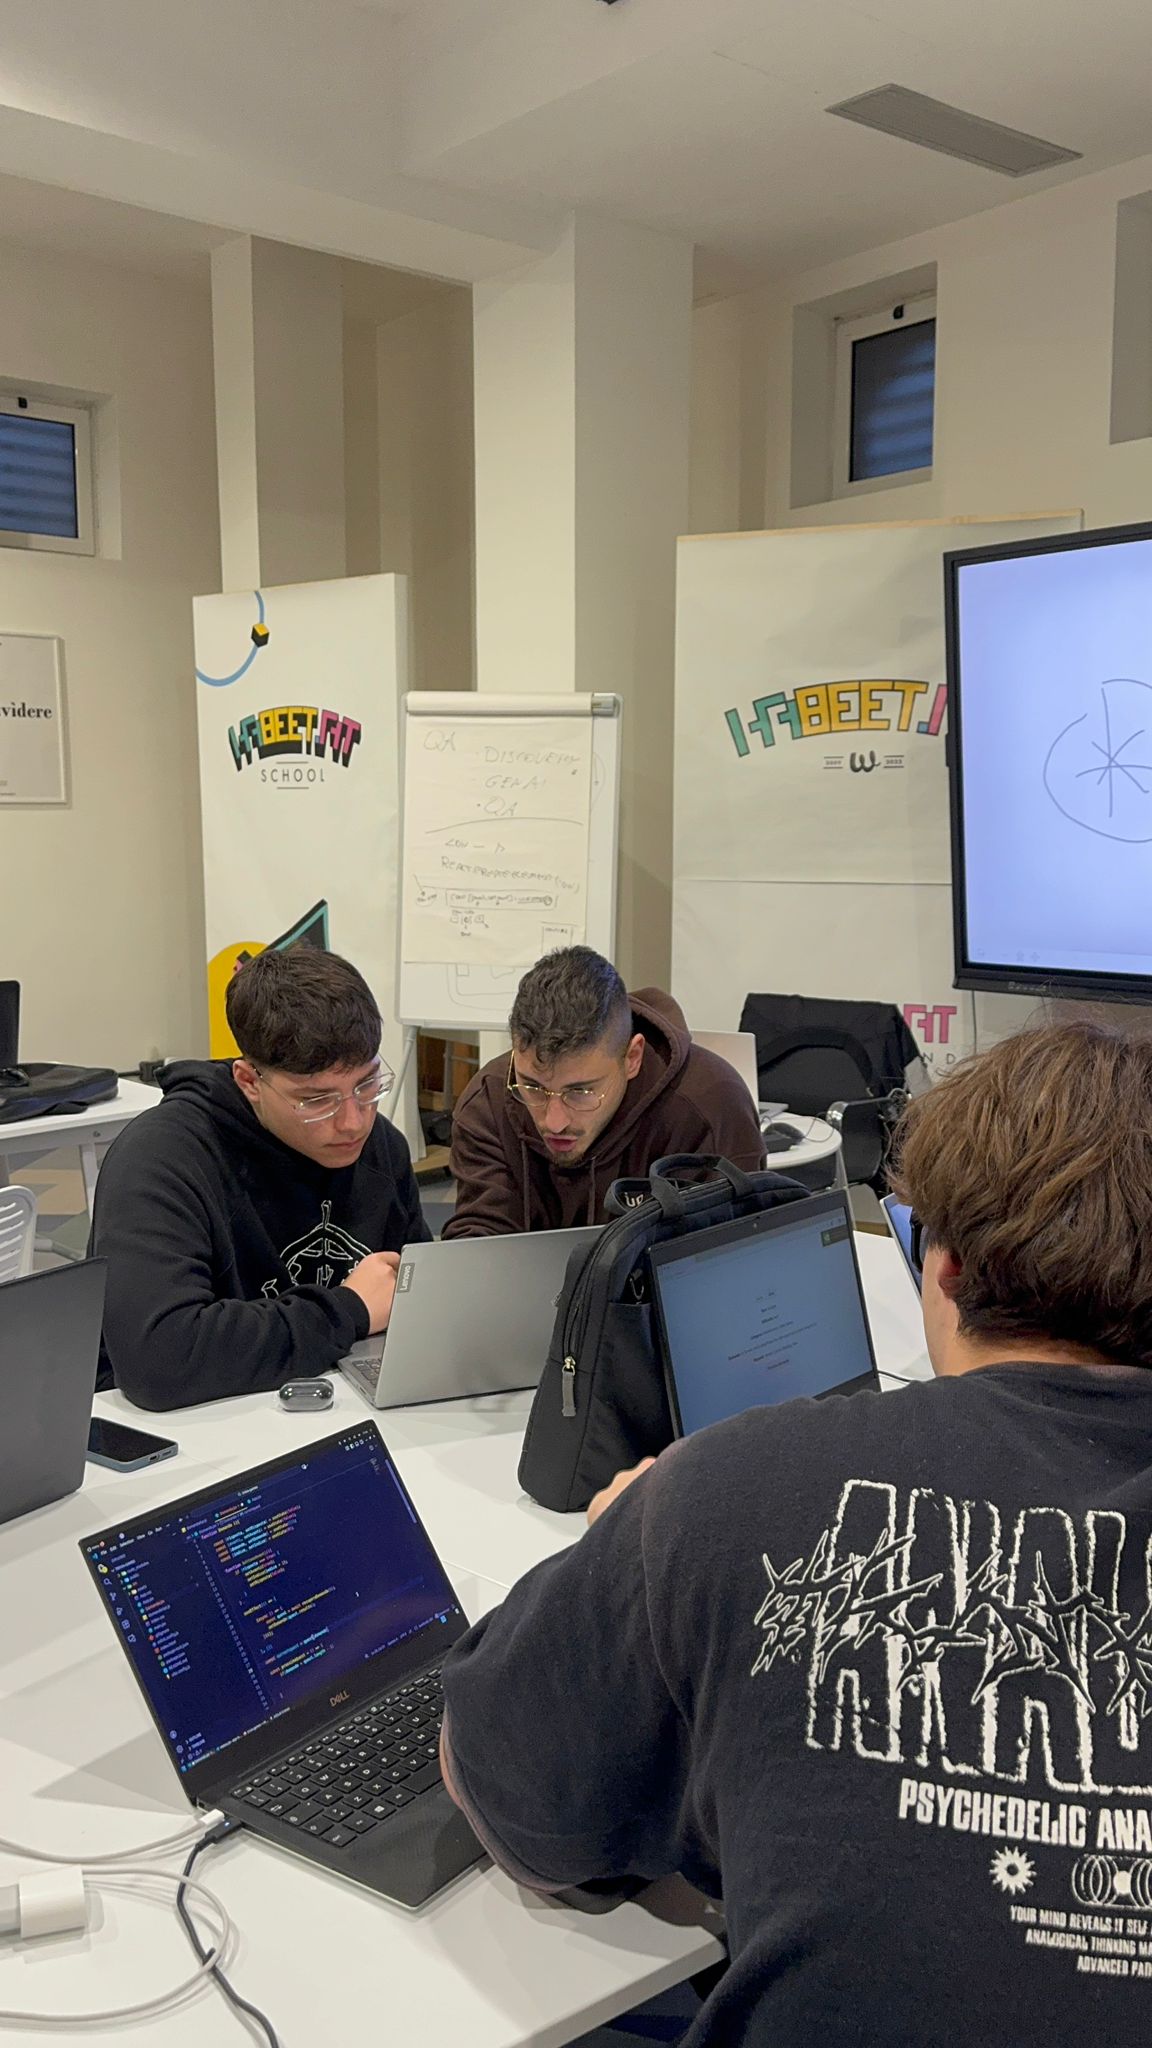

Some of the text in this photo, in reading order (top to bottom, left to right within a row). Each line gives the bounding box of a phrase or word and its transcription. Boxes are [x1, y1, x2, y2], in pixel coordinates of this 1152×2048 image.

[0, 702, 52, 719] vìdere
[261, 768, 326, 783] SCHOOL
[400, 1265, 411, 1290] Lenovo
[330, 1690, 350, 1707] DELL
[898, 1778, 1152, 1852] PSYCHEDELIC ANA
[1010, 1905, 1149, 1936] YOUR MIND REVEALS IT SELF
[1025, 1928, 1089, 1950] ANALOGICAL
[1091, 1936, 1136, 1956] THINKING
[1077, 1955, 1129, 1975] ADVANCED
